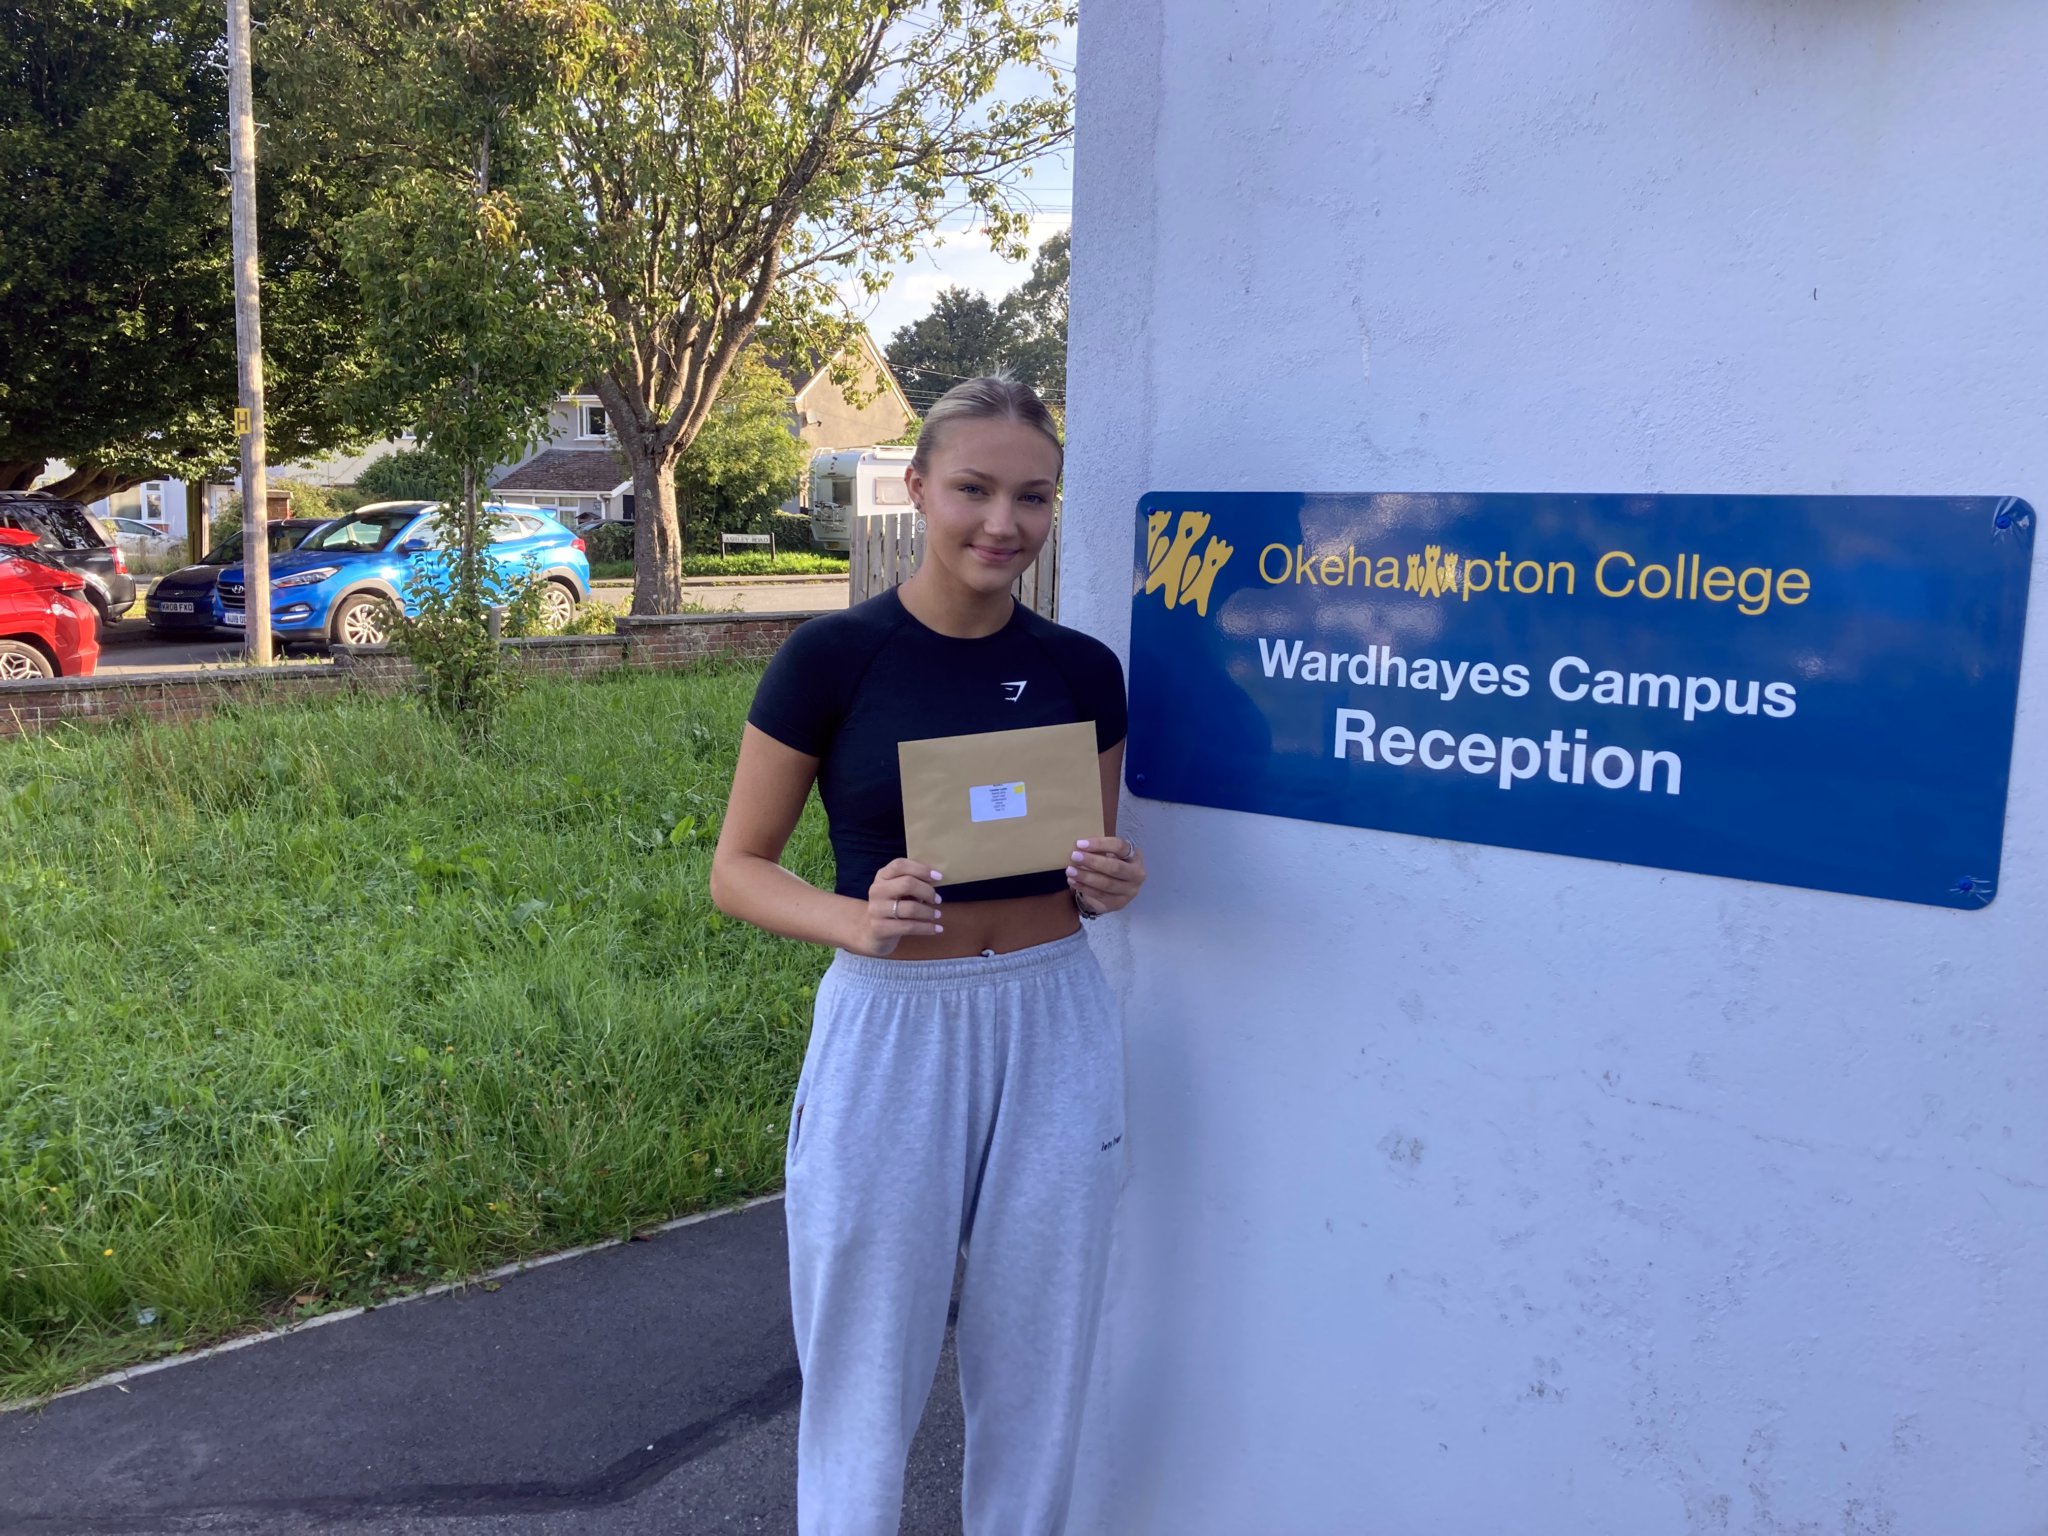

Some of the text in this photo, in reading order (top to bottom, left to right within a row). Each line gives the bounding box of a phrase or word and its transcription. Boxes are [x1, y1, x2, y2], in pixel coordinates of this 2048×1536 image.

[237, 411, 248, 431] H
[1594, 550, 1812, 616] College
[1257, 638, 1798, 722] Wardhayes Campus
[1333, 707, 1683, 796] Reception
